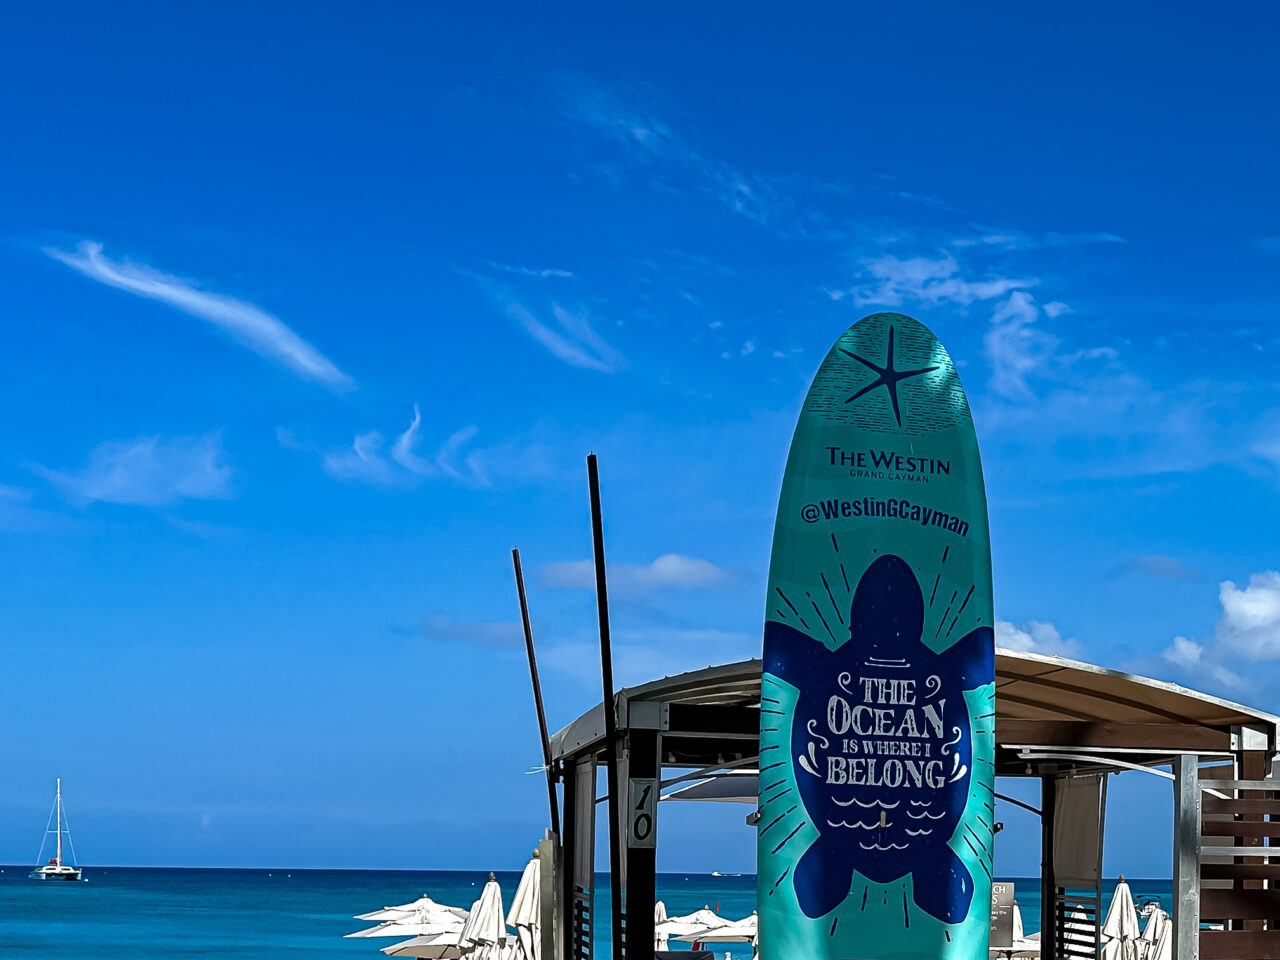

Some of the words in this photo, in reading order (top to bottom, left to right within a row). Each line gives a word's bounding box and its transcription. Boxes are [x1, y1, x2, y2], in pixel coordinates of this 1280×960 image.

[825, 446, 867, 467] THE
[869, 449, 950, 475] WESTIN
[850, 469, 885, 480] GRAND
[888, 472, 929, 484] CAYMAN
[801, 496, 970, 537] @WestinGCayman
[859, 676, 917, 706] THE
[827, 695, 947, 739] OCEAN
[842, 739, 859, 754] IS
[862, 740, 922, 757] WHERE
[924, 743, 931, 758] I
[826, 756, 946, 789] BELONG
[634, 784, 652, 841] 10
